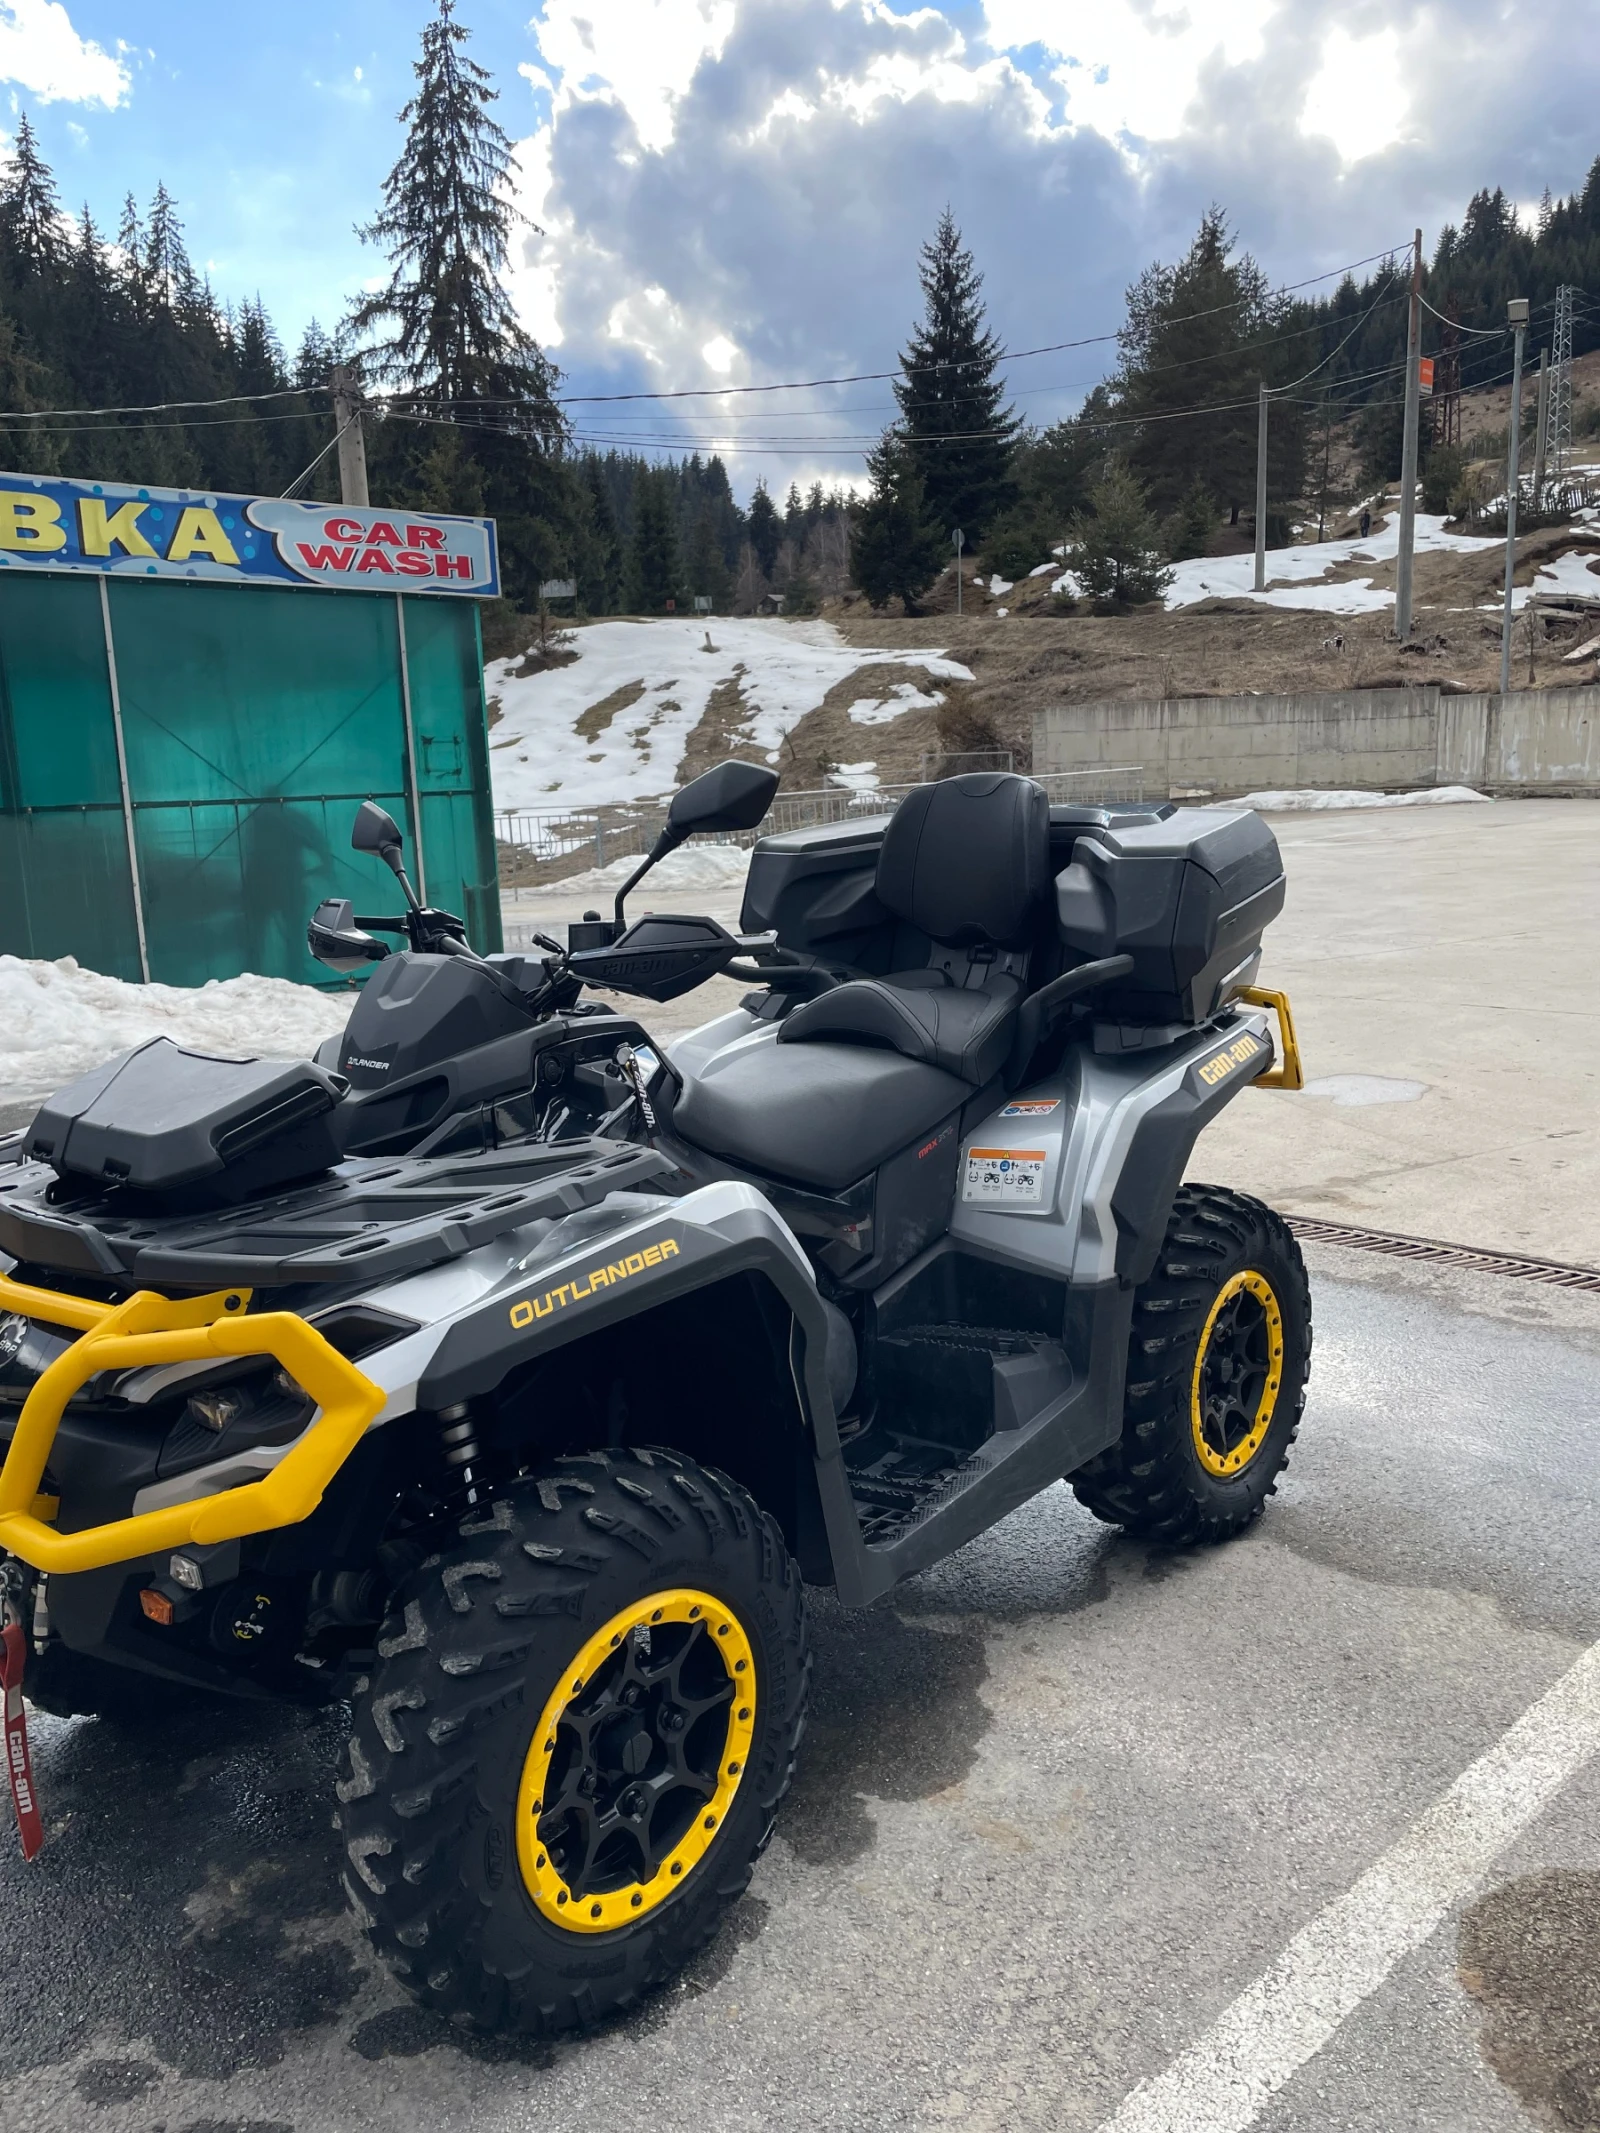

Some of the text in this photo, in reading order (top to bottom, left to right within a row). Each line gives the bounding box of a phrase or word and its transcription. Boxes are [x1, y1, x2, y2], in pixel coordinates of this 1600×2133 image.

[323, 517, 446, 551] CAR
[295, 542, 473, 580] WASH
[1199, 1036, 1259, 1085] can-am
[918, 1138, 938, 1159] MAX
[509, 1238, 680, 1330] OUTLANDER
[9, 1730, 33, 1814] can-am
